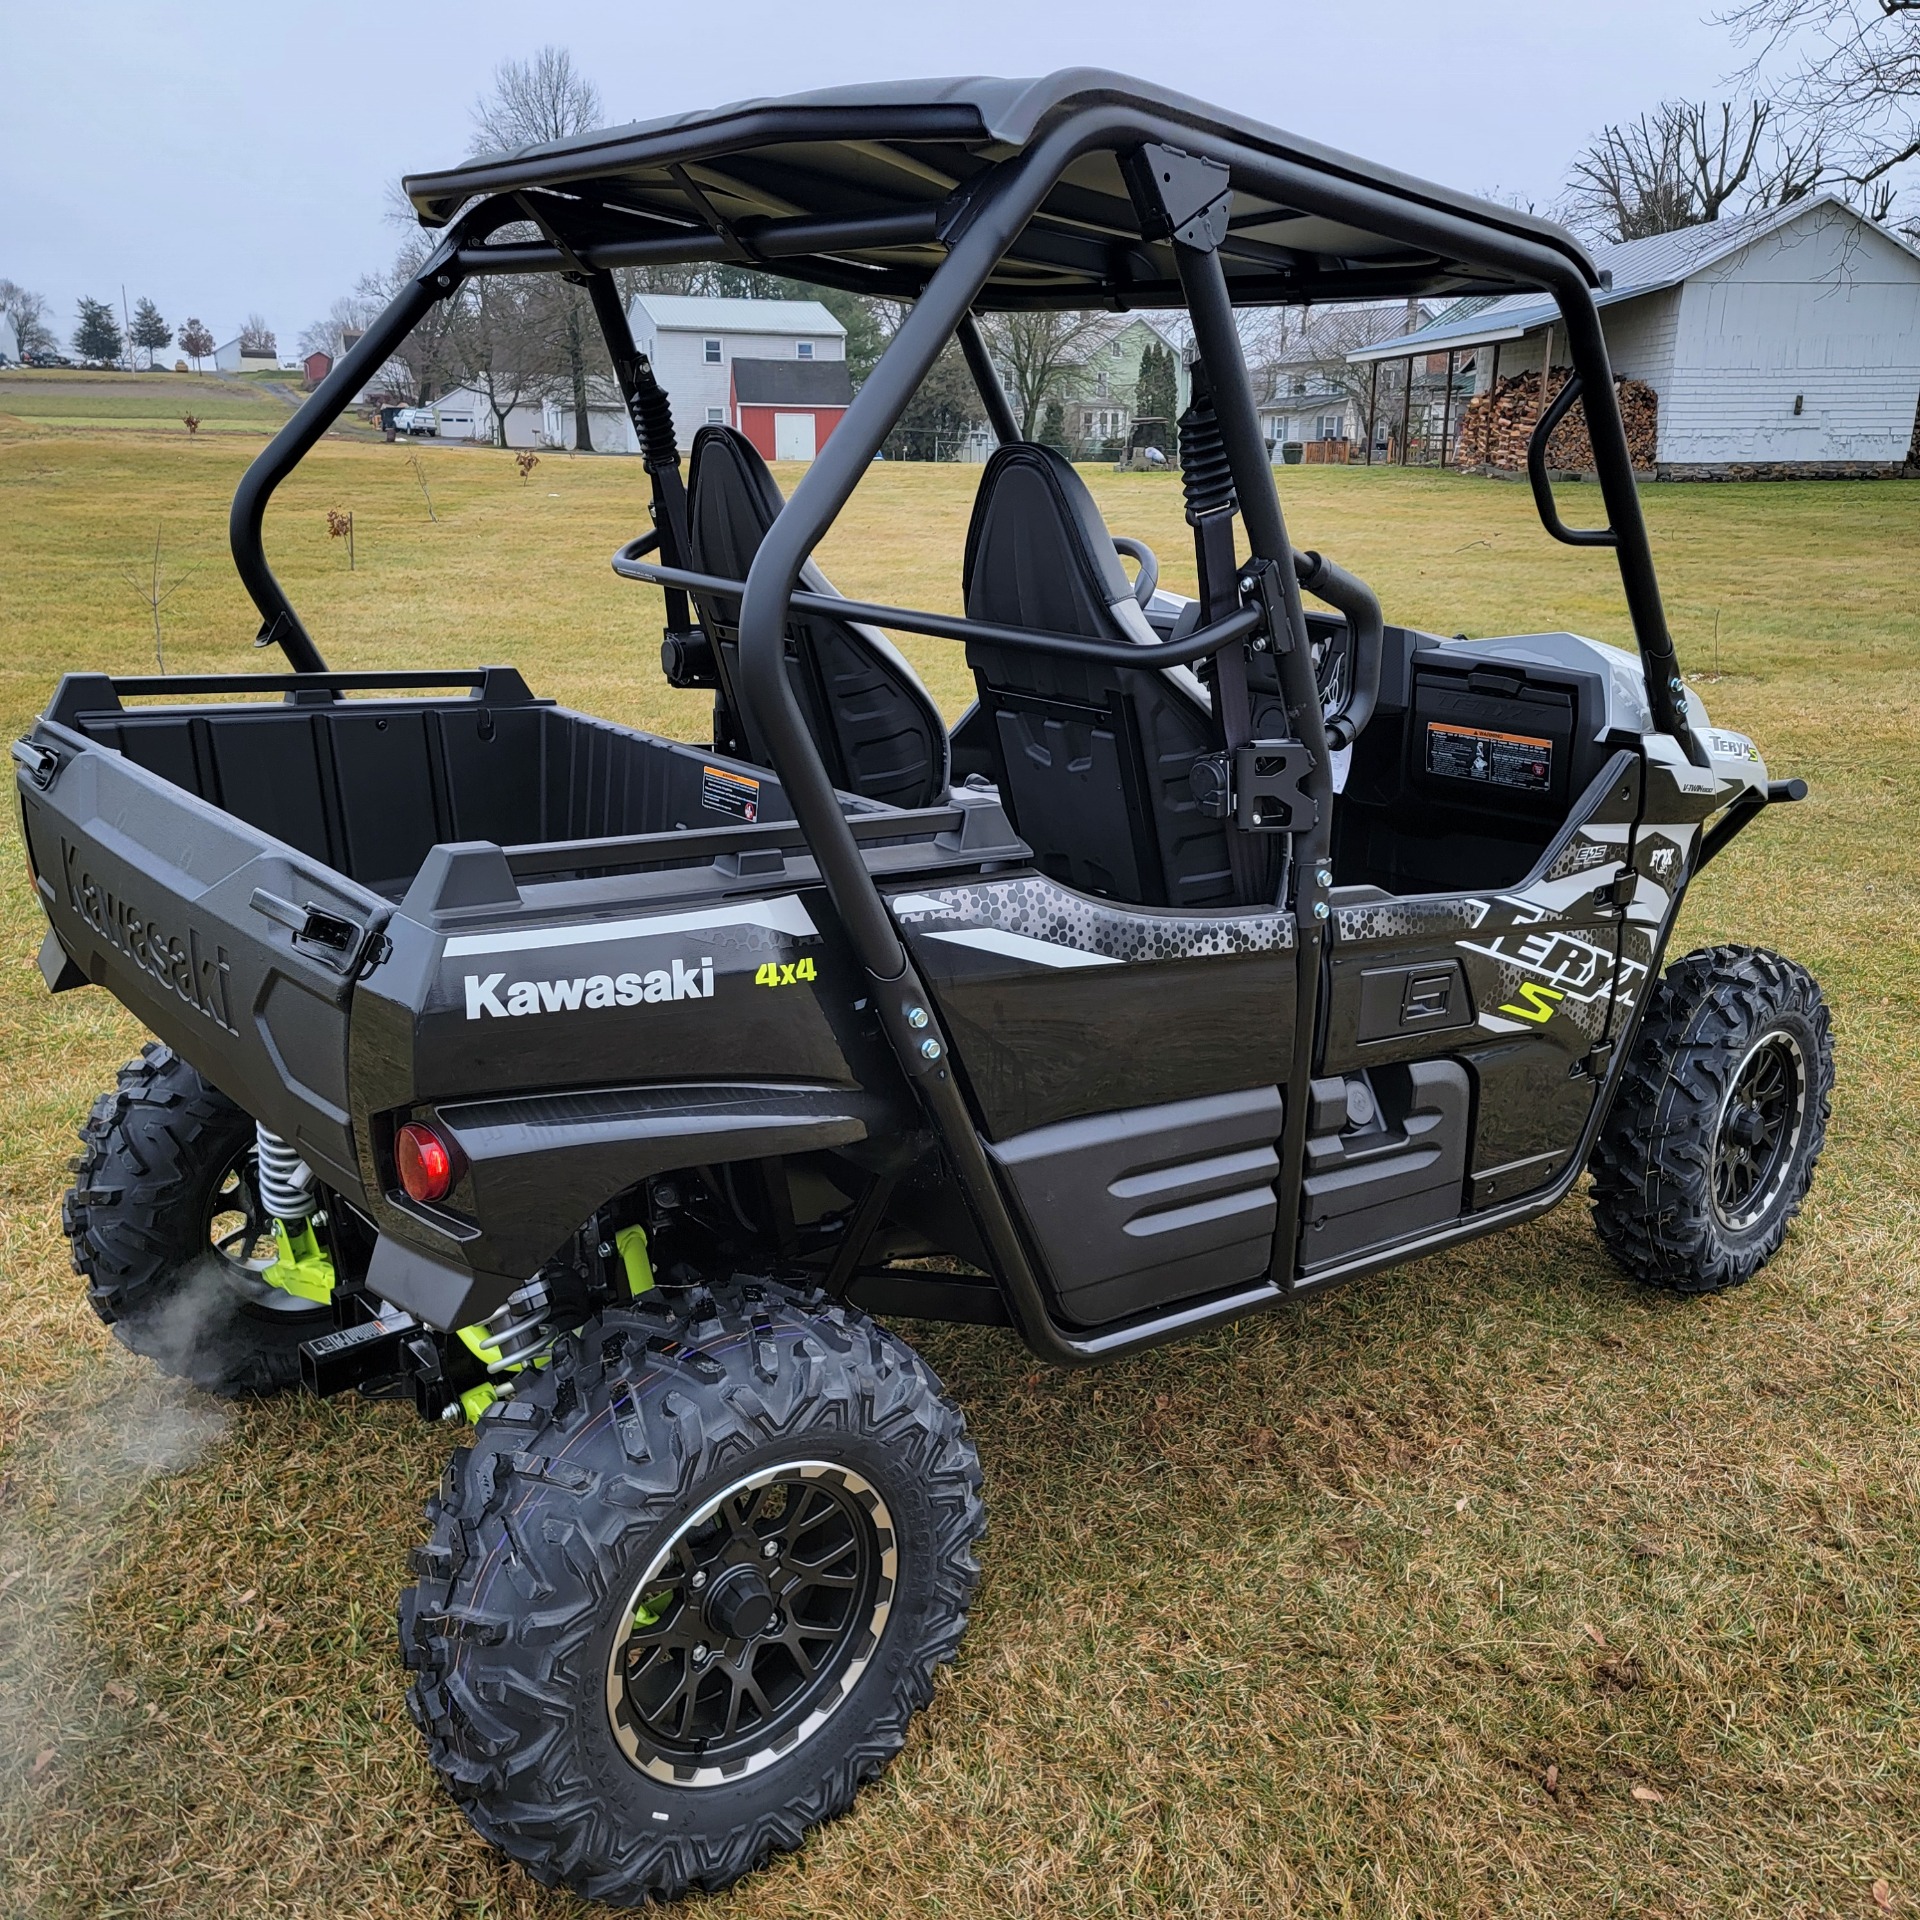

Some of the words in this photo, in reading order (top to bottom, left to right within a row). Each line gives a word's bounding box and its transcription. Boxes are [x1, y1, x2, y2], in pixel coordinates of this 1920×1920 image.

[1649, 847, 1675, 875] FOX
[61, 836, 241, 1038] Kawasaki
[464, 957, 715, 1020] Kawasaki
[755, 957, 817, 988] 4x4
[1497, 981, 1566, 1025] S
